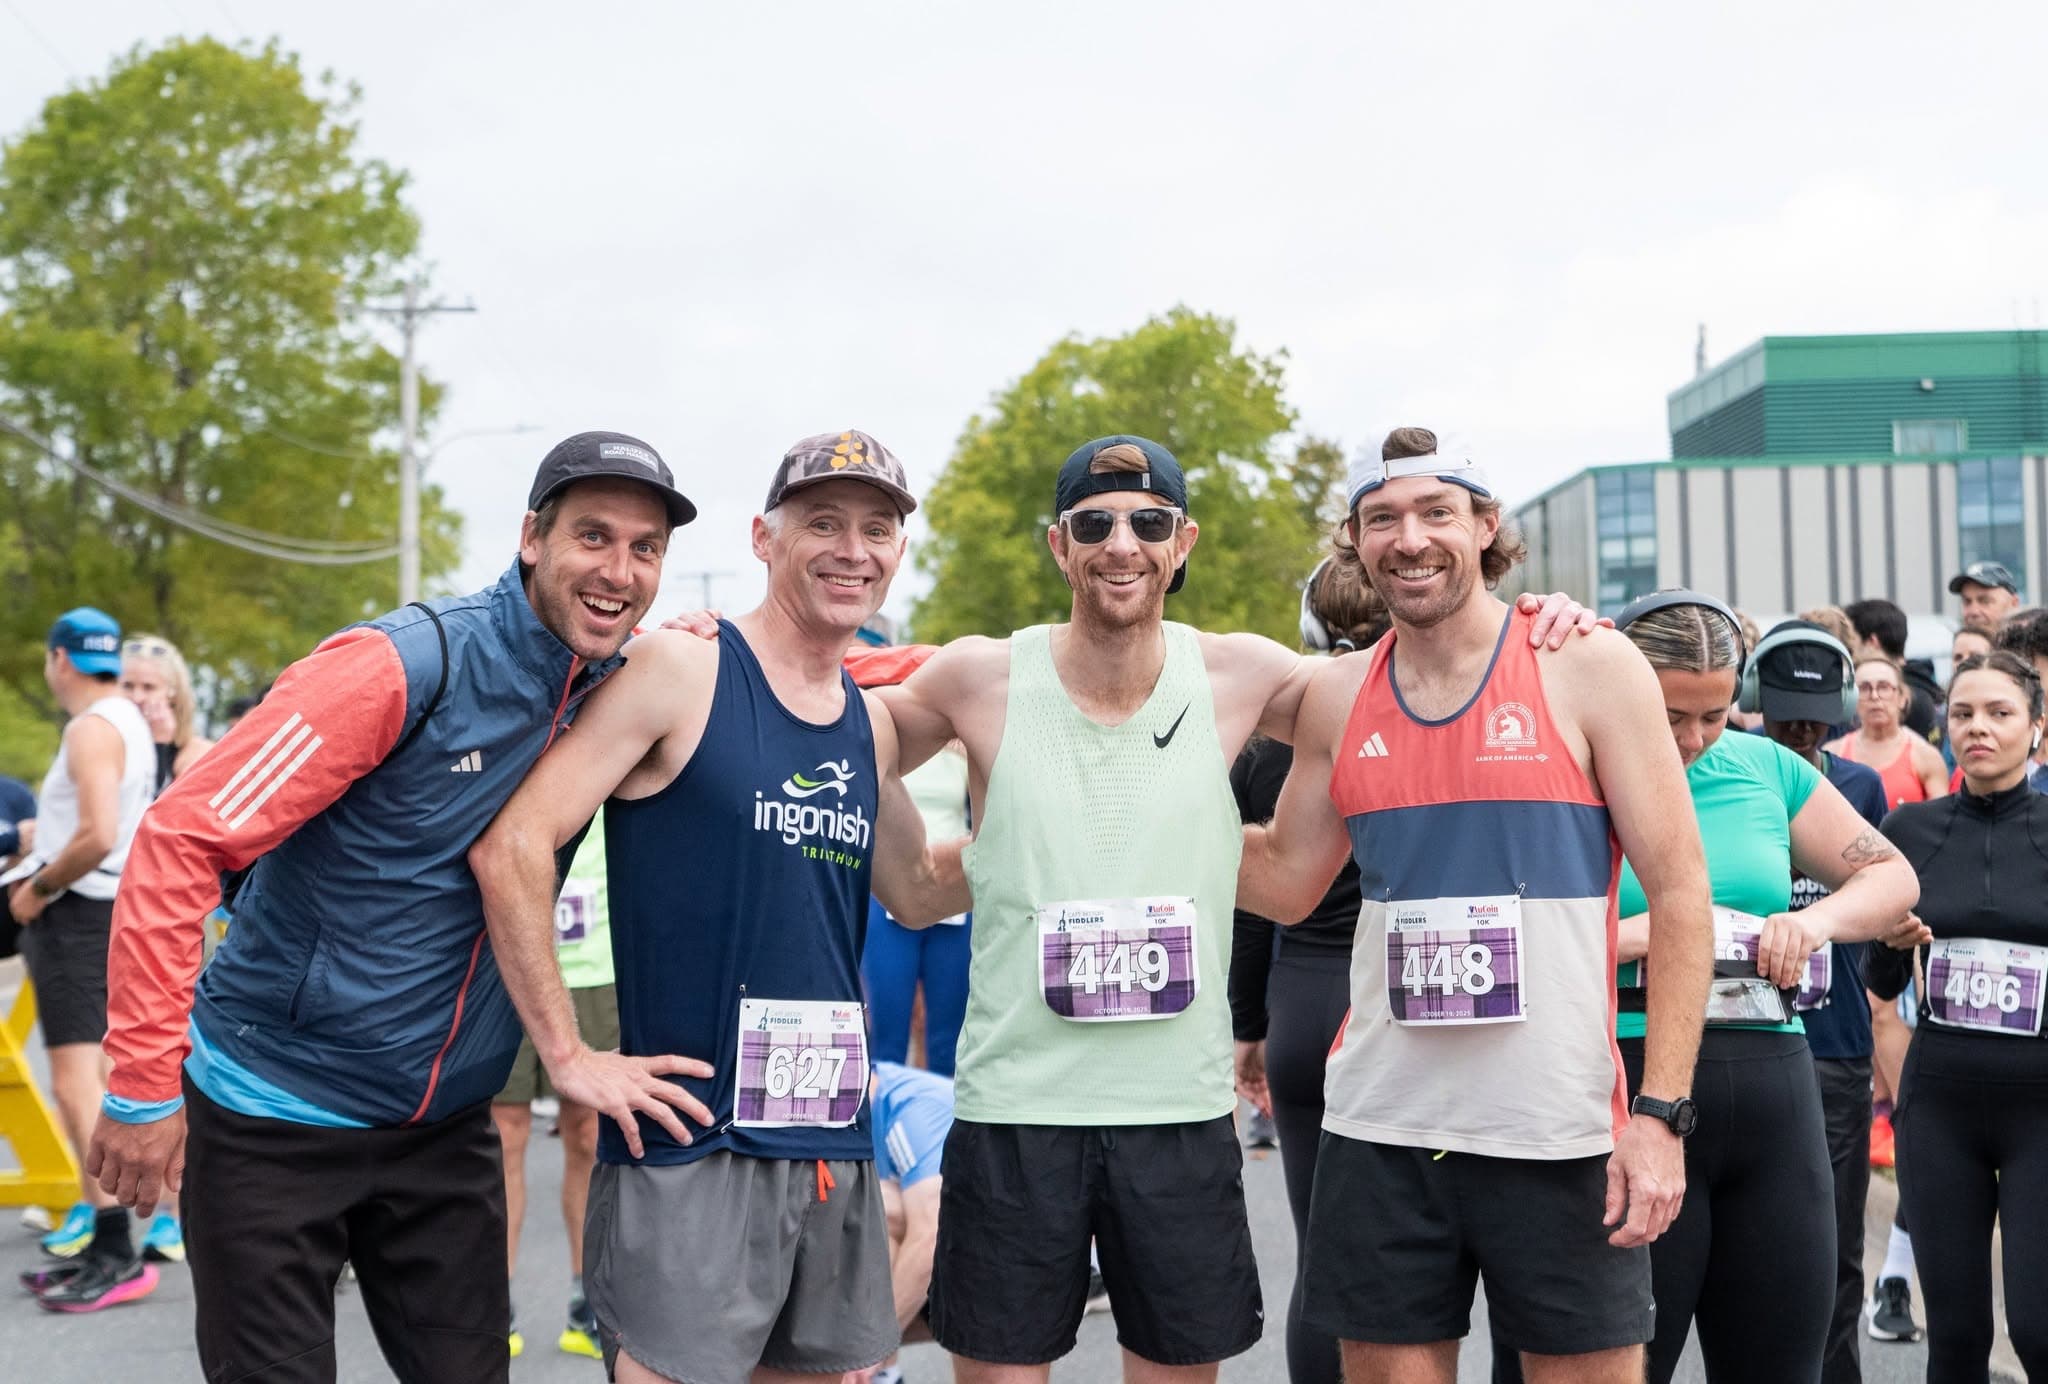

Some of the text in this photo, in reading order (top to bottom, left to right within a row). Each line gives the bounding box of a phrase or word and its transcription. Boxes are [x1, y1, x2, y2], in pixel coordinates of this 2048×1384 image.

[754, 790, 870, 850] ingonish
[1068, 916, 1104, 924] FIDDLERS
[1152, 904, 1175, 913] AuCoin
[1400, 916, 1427, 925] FIDDLERS
[1472, 904, 1499, 914] AuCoin
[1067, 941, 1171, 995] 449
[1401, 943, 1495, 997] 448
[1944, 969, 2022, 1014] 496
[770, 1017, 802, 1025] FIDDLERS
[764, 1045, 848, 1099] 627
